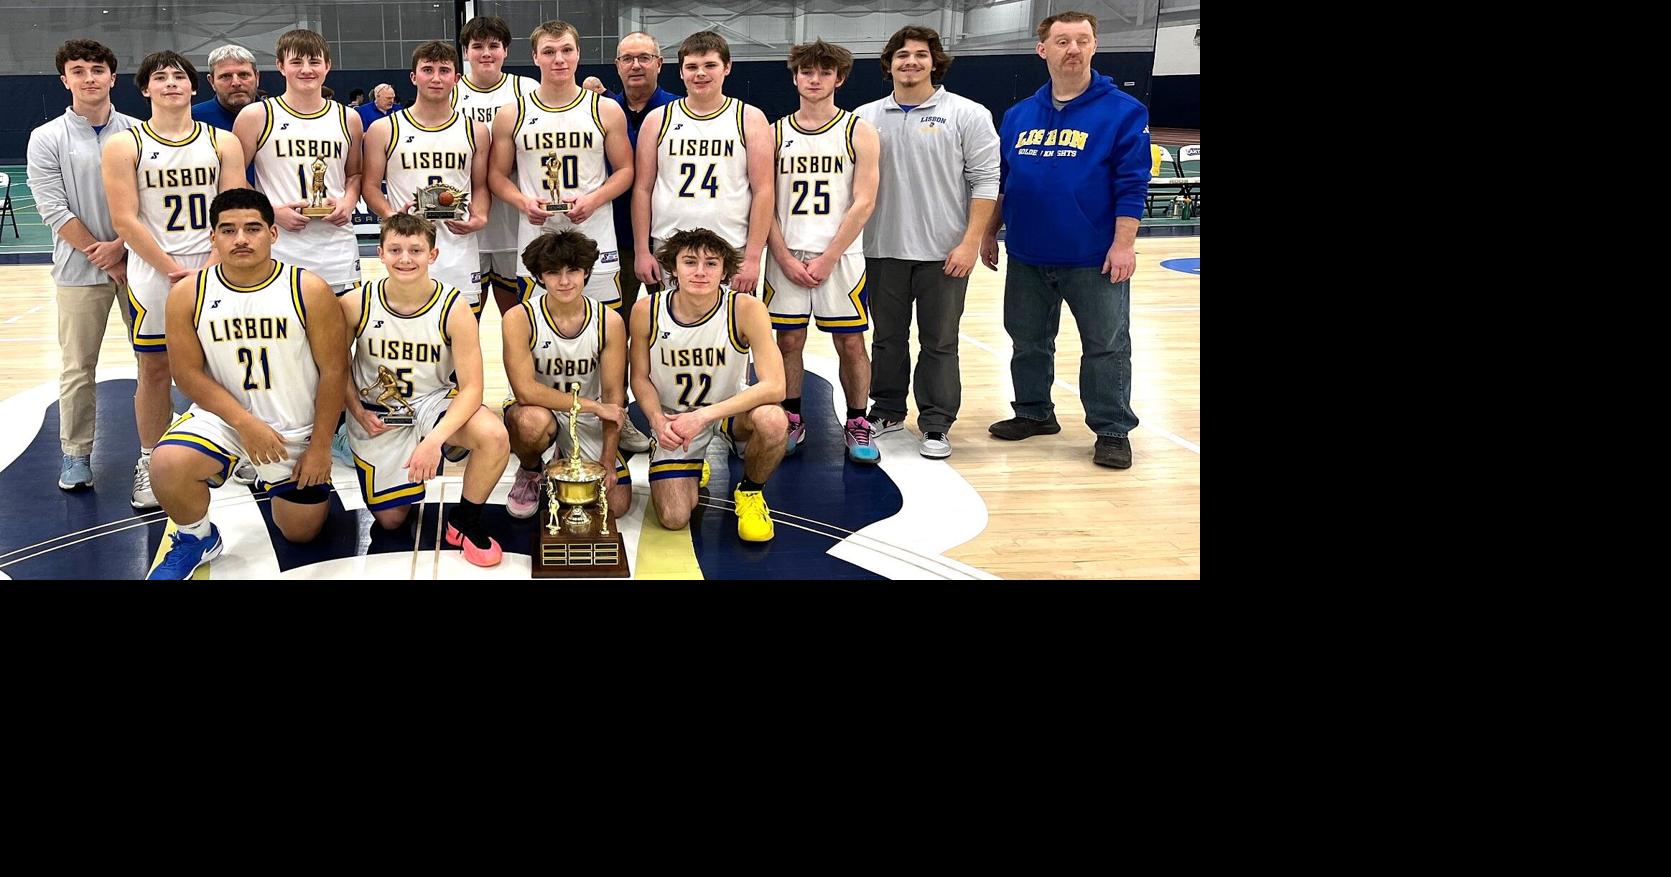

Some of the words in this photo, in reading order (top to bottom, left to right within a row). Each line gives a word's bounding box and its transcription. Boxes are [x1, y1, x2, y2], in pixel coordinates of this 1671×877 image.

[920, 116, 947, 124] LISBON
[275, 138, 343, 159] LISBON
[523, 131, 593, 151] LISBON
[669, 138, 735, 157] LISBON
[400, 151, 467, 170] LISBON
[779, 155, 844, 175] LISBON
[145, 166, 217, 189] LISBON
[678, 162, 719, 199] 24
[791, 179, 831, 215] 25
[163, 192, 208, 232] 20
[209, 317, 288, 343] LISBON
[368, 337, 442, 363] LISBON
[660, 346, 727, 367] LISBON
[237, 346, 272, 391] 21
[534, 357, 599, 377] LISBON
[396, 367, 414, 398] 5
[675, 372, 713, 407] 22
